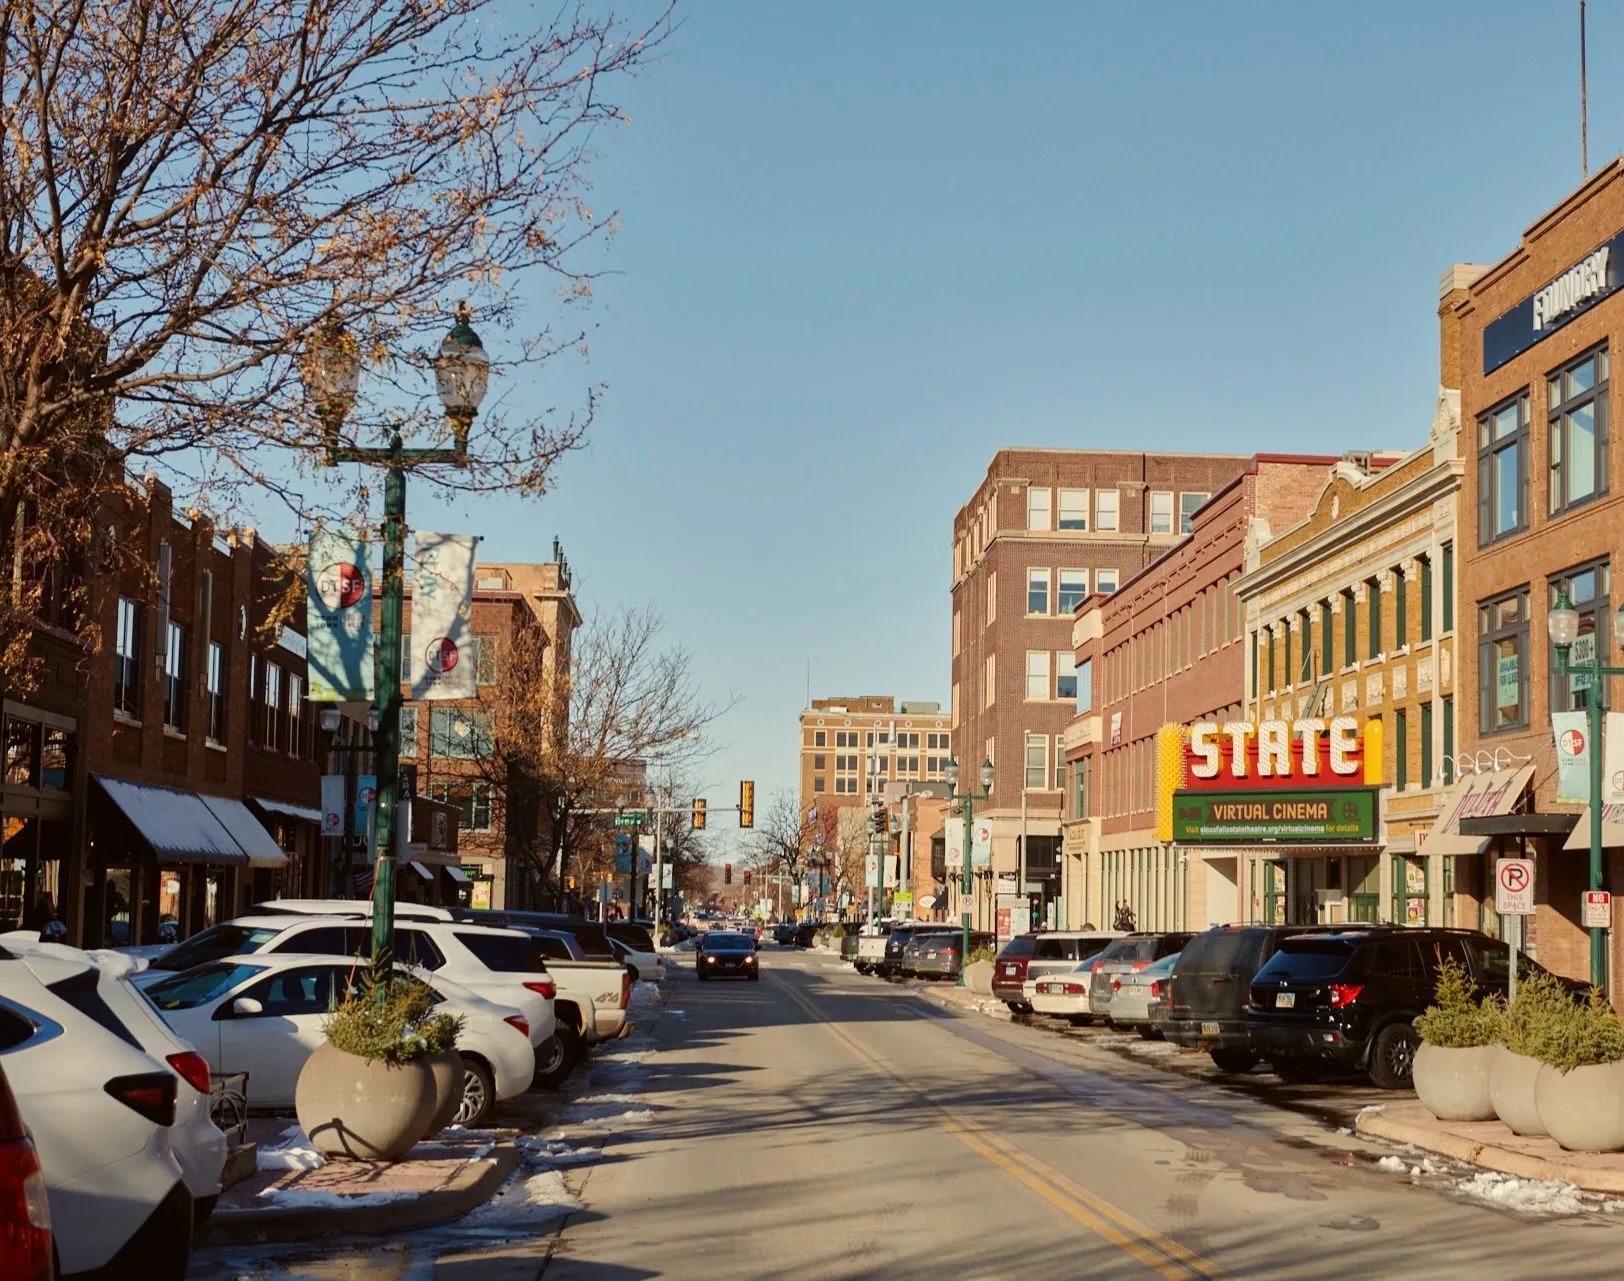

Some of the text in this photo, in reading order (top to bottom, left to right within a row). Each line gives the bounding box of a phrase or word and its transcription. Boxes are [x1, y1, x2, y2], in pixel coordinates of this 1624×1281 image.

[1533, 246, 1609, 331] FOUNDRY
[321, 579, 359, 593] DTSF
[1190, 716, 1360, 778] STATE
[1213, 803, 1328, 820] VIRTUAL CINEMA
[1185, 825, 1200, 834] Visit
[1325, 823, 1335, 832] for
[1336, 823, 1359, 832] details
[1592, 892, 1605, 903] NO
[1503, 902, 1527, 910] SPACE
